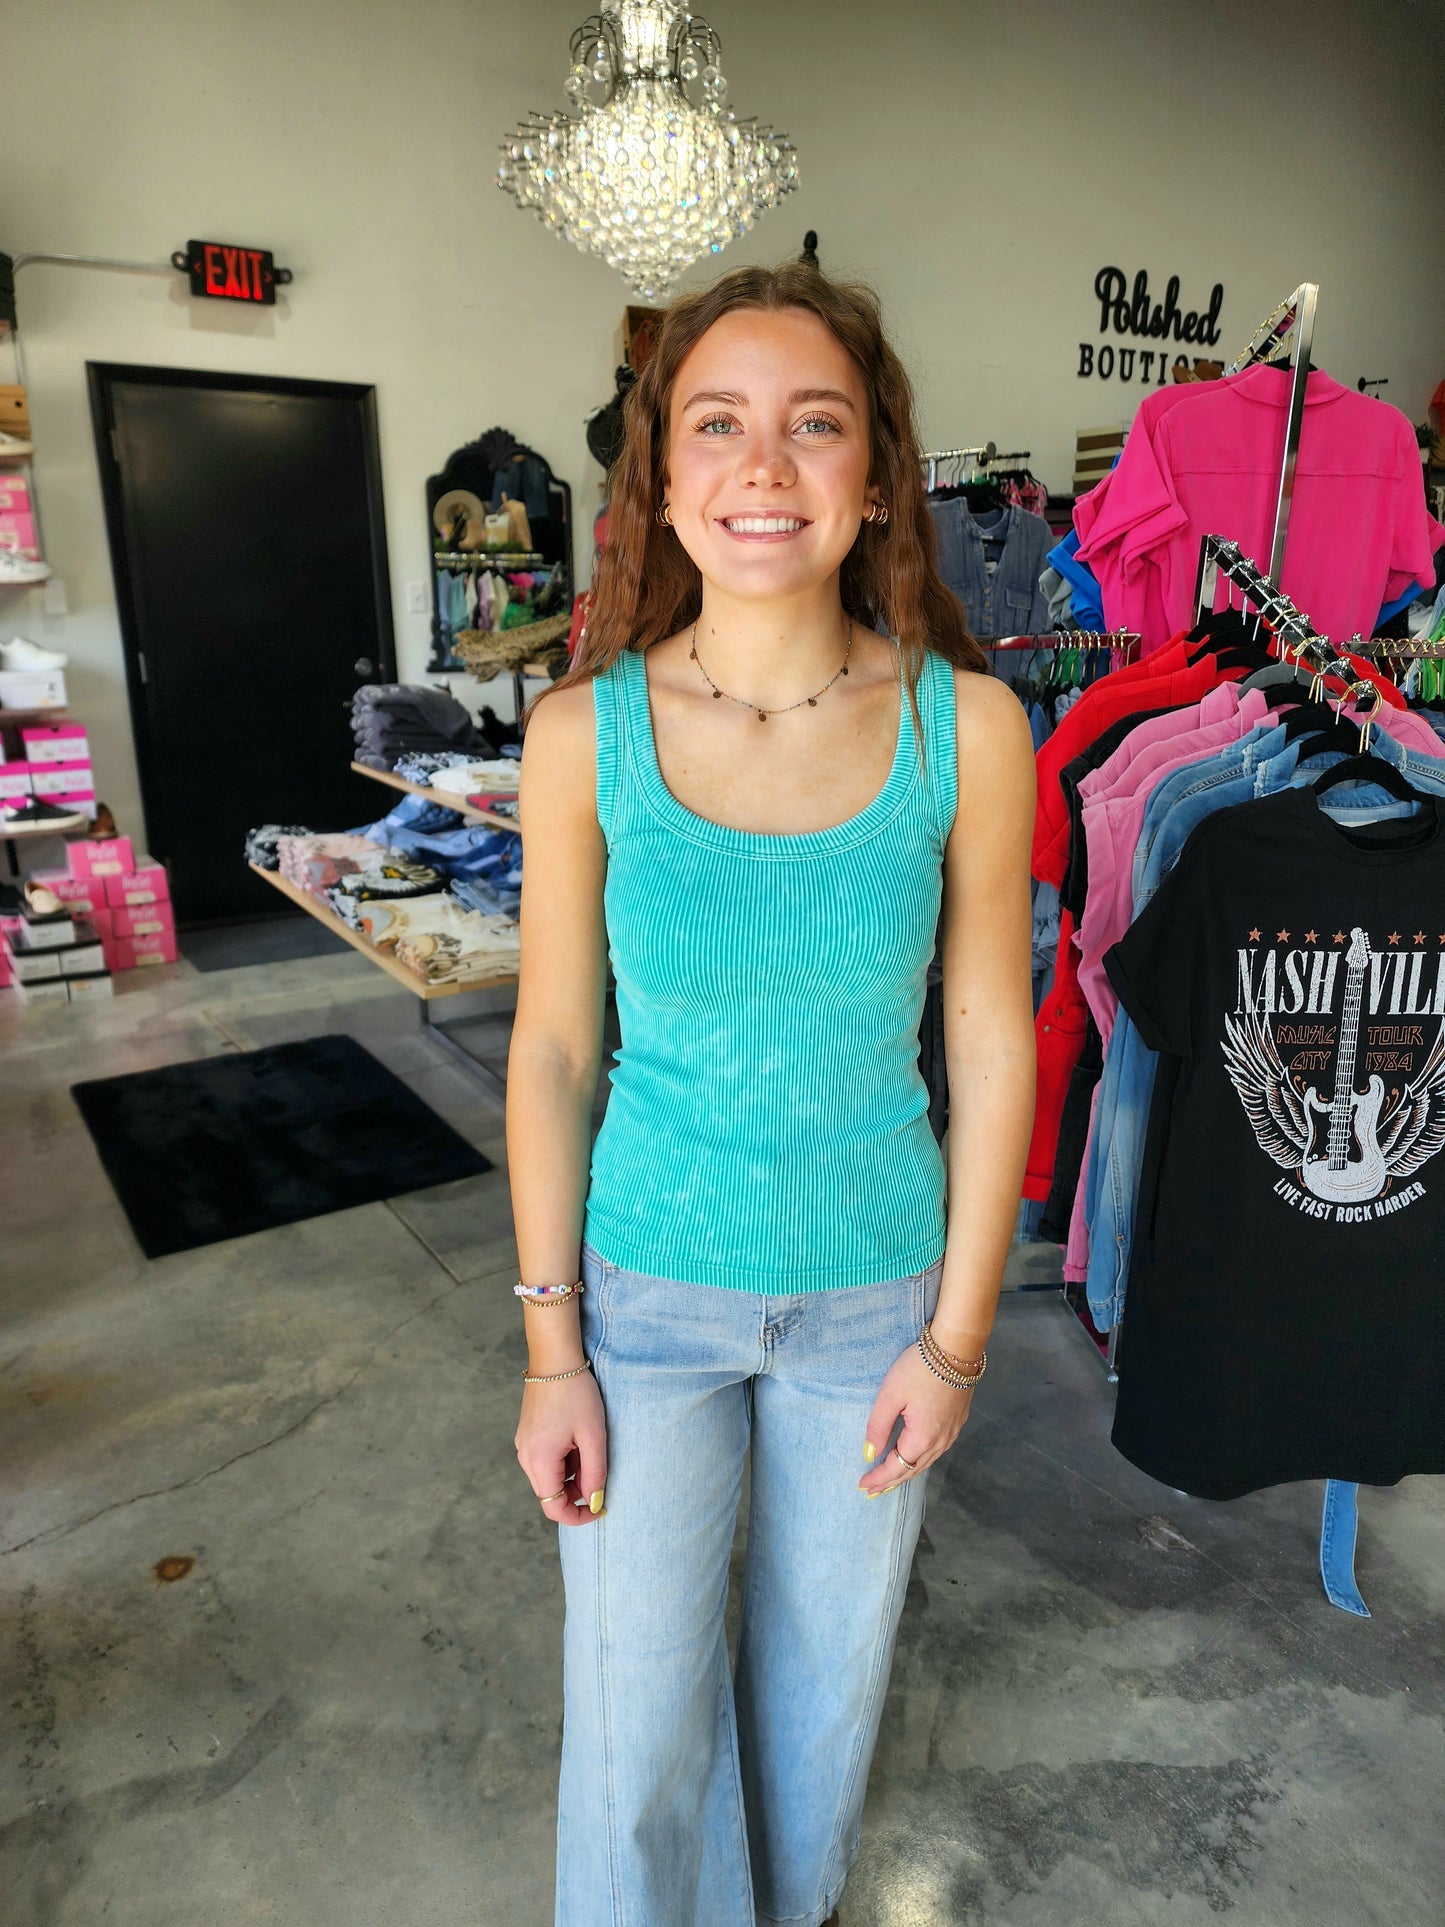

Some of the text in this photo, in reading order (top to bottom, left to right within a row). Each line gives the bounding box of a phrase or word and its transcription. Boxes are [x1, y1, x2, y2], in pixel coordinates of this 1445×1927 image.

[204, 244, 264, 301] EXIT
[1095, 266, 1224, 347] Polished
[1077, 343, 1225, 386] BOUTI
[1276, 1024, 1337, 1045] MUSIC
[1367, 1025, 1424, 1046] TOUR
[1290, 1050, 1332, 1071] CITY
[1365, 1051, 1414, 1072] 1984
[1272, 1177, 1427, 1223] LIVE FAST ROCK HARDER
